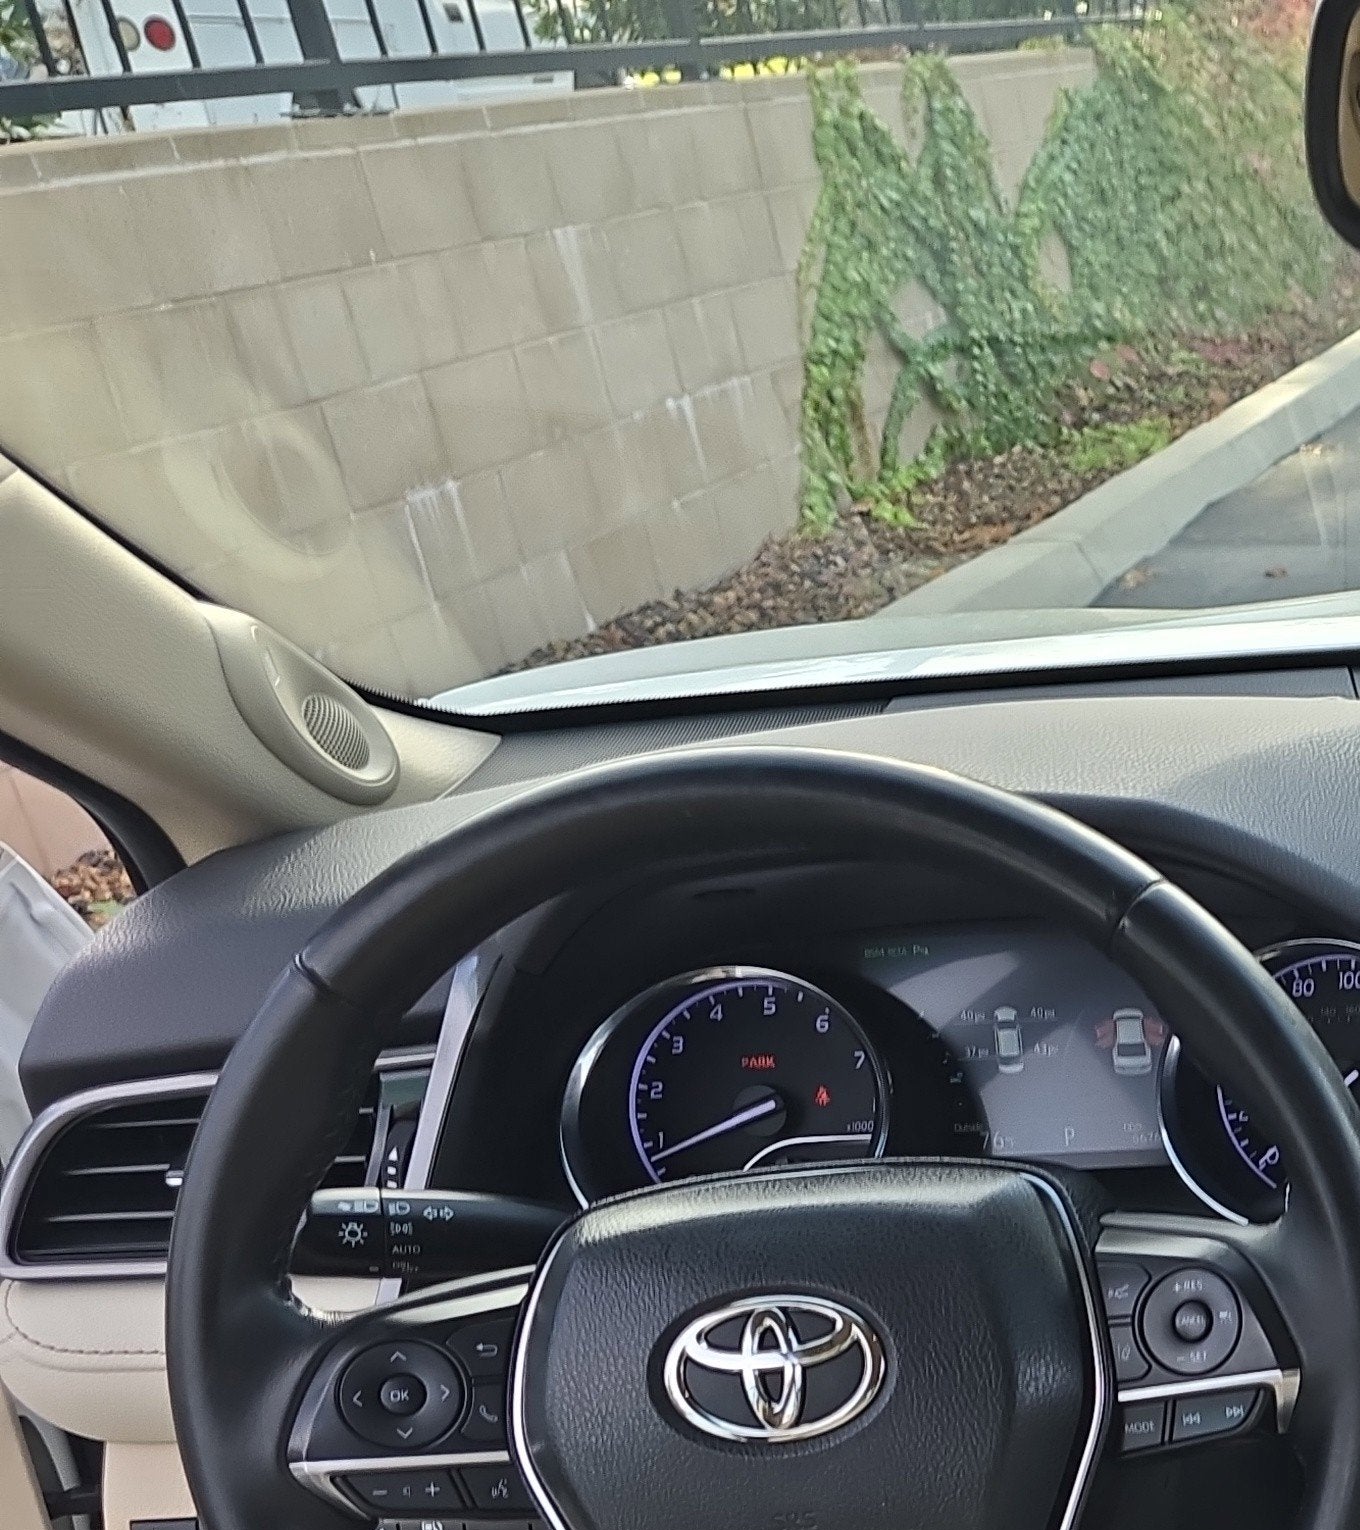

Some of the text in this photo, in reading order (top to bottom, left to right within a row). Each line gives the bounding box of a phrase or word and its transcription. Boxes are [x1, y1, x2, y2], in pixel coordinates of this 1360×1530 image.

[1293, 979, 1315, 997] 80
[710, 1006, 723, 1021] 4
[763, 997, 776, 1015] 5
[816, 1015, 828, 1033] 6
[672, 1036, 683, 1054] 3
[853, 1050, 865, 1069] 7
[651, 1083, 663, 1099] 2
[657, 1131, 664, 1148] 1
[1064, 1127, 1075, 1146] P
[392, 1244, 421, 1255] AUTO
[390, 1389, 410, 1402] OK
